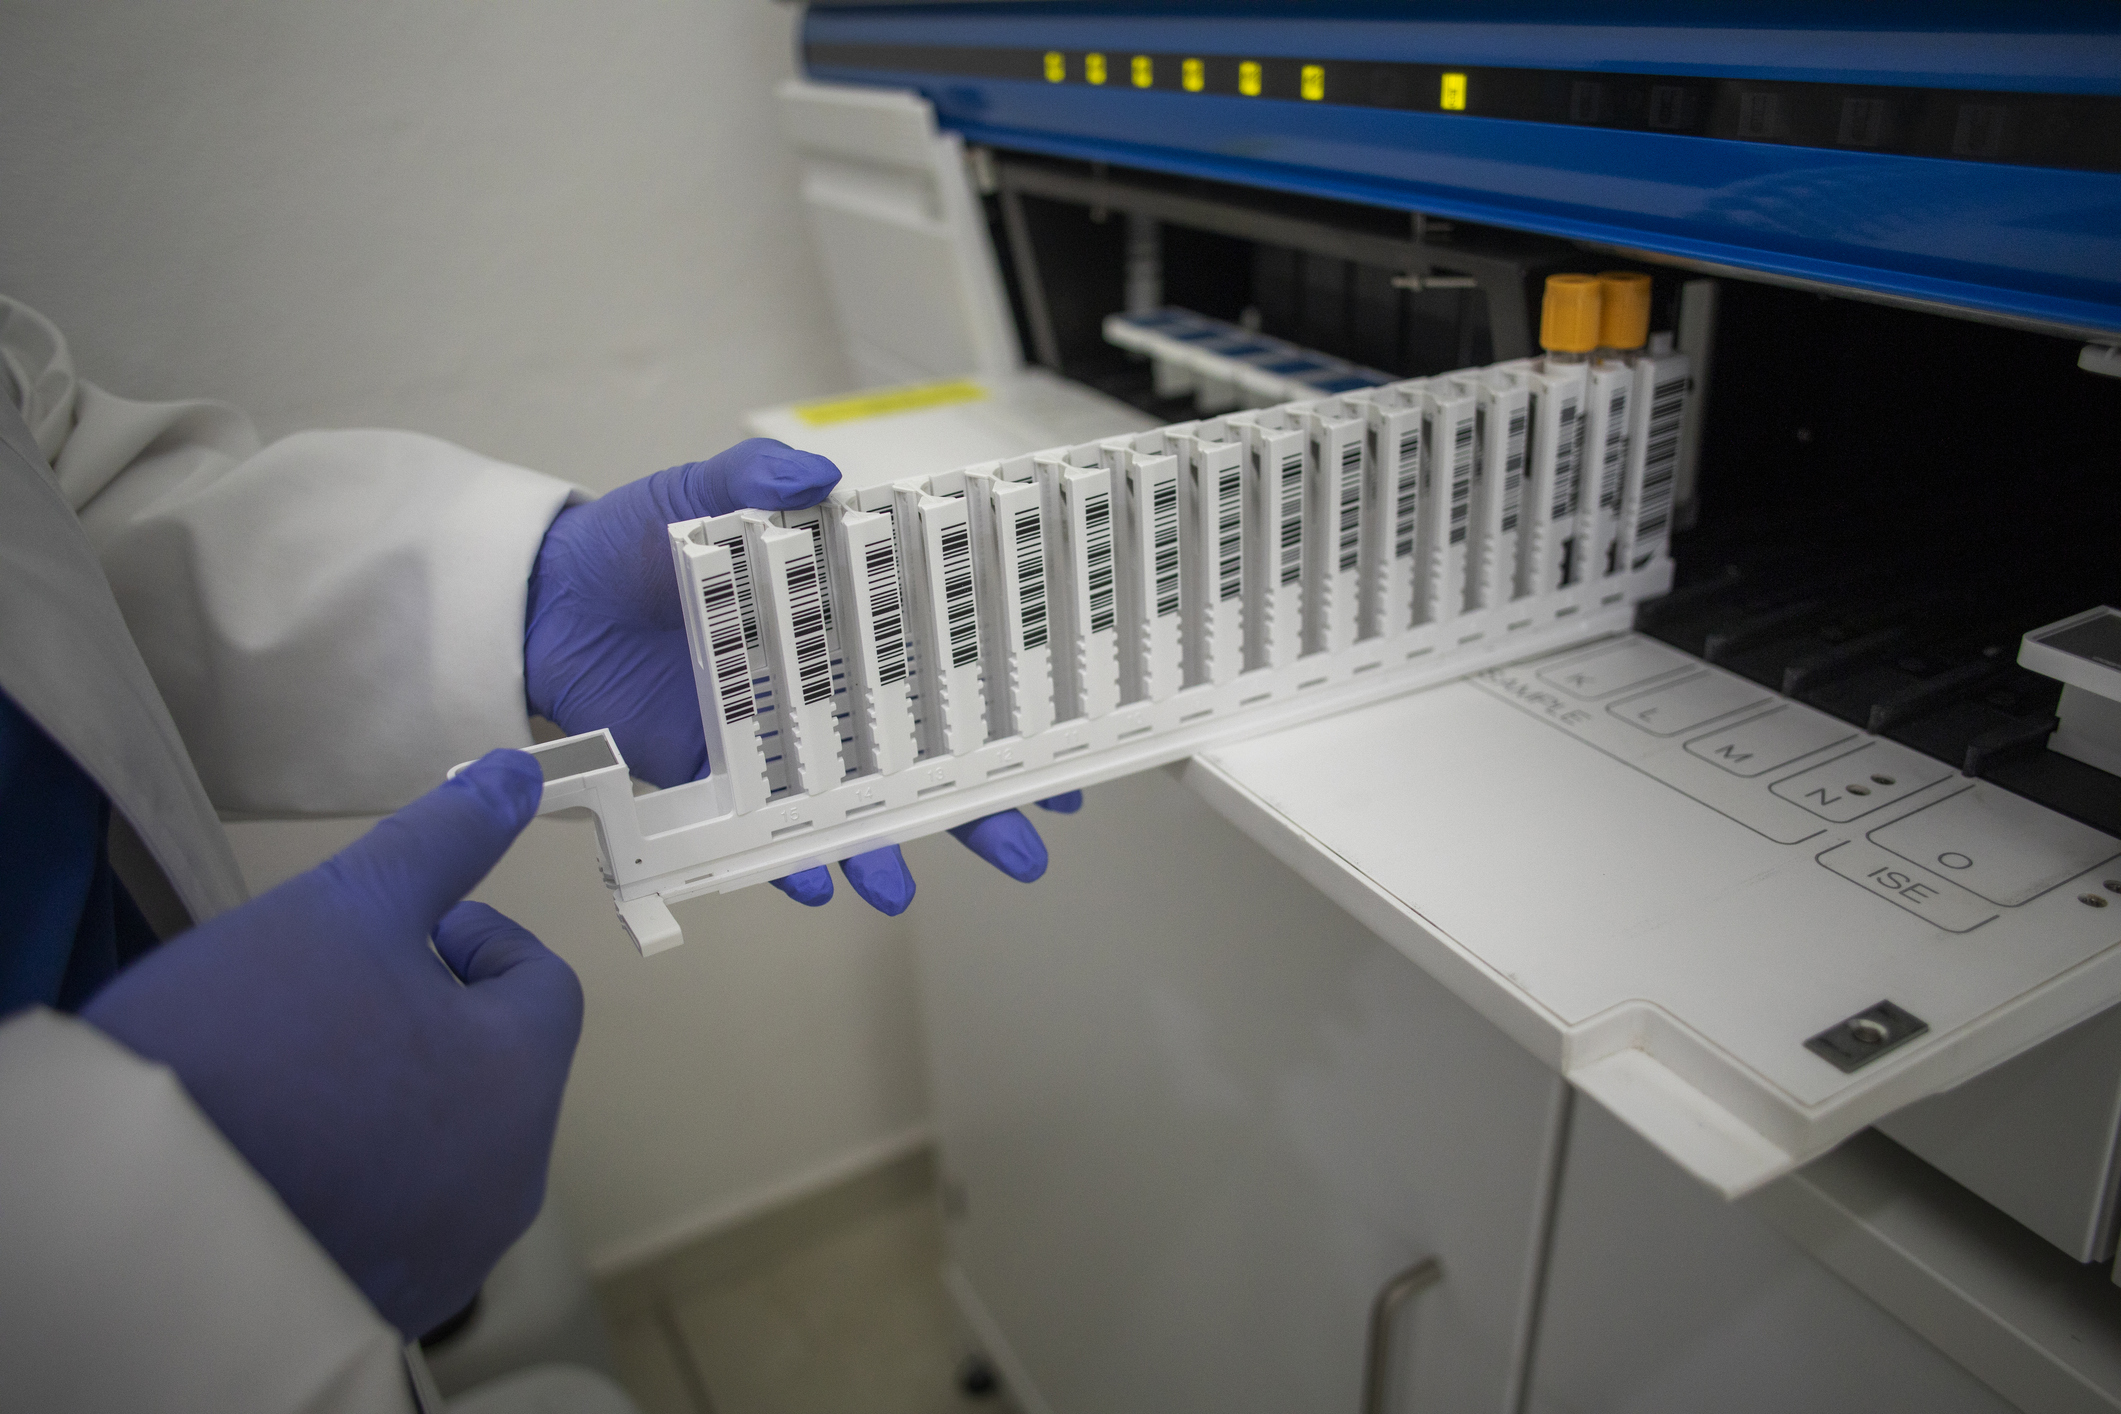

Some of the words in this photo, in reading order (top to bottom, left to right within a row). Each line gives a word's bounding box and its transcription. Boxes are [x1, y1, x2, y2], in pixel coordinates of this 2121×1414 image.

[1714, 744, 1754, 763] M
[926, 766, 945, 782] 13
[855, 786, 873, 801] 14
[1804, 787, 1842, 806] N
[780, 806, 800, 823] 15
[1866, 866, 1940, 904] ISE
